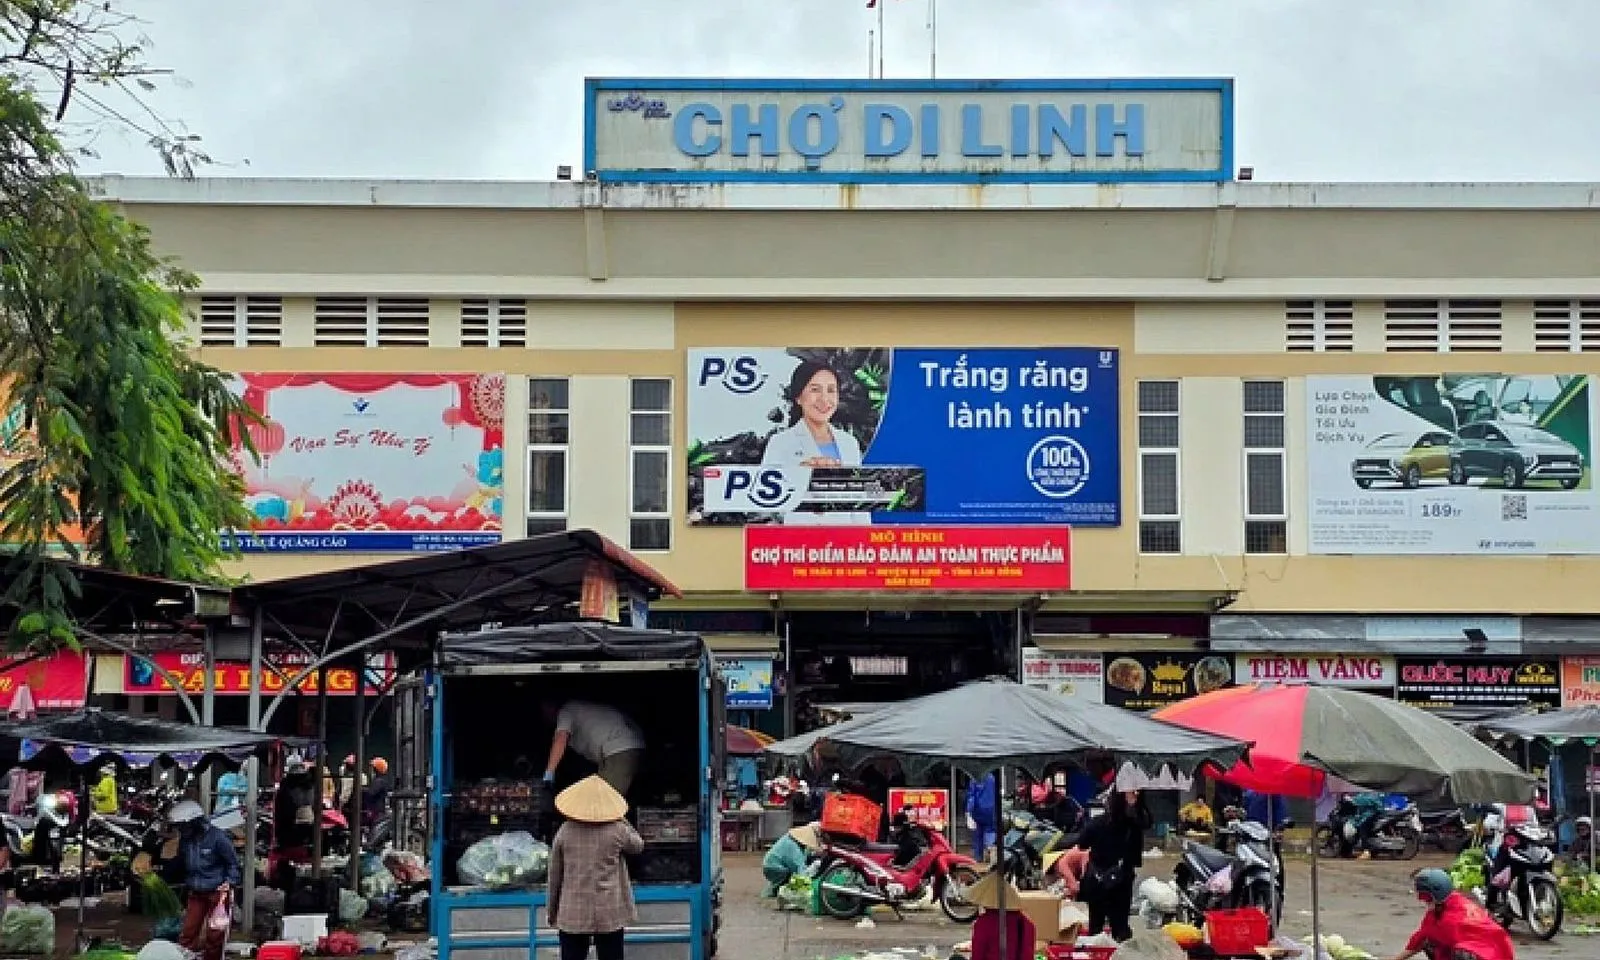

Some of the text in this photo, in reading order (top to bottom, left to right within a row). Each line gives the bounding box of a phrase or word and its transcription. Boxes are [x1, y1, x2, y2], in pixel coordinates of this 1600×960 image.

[672, 94, 844, 170] CHỢ
[864, 103, 939, 156] DI
[962, 103, 1146, 157] LINH
[919, 353, 1088, 391] Trắng răng
[948, 401, 1011, 428] lành
[752, 546, 779, 566] CHỢ
[917, 548, 935, 563] AN
[1249, 653, 1383, 683] TIỆM VÀNG
